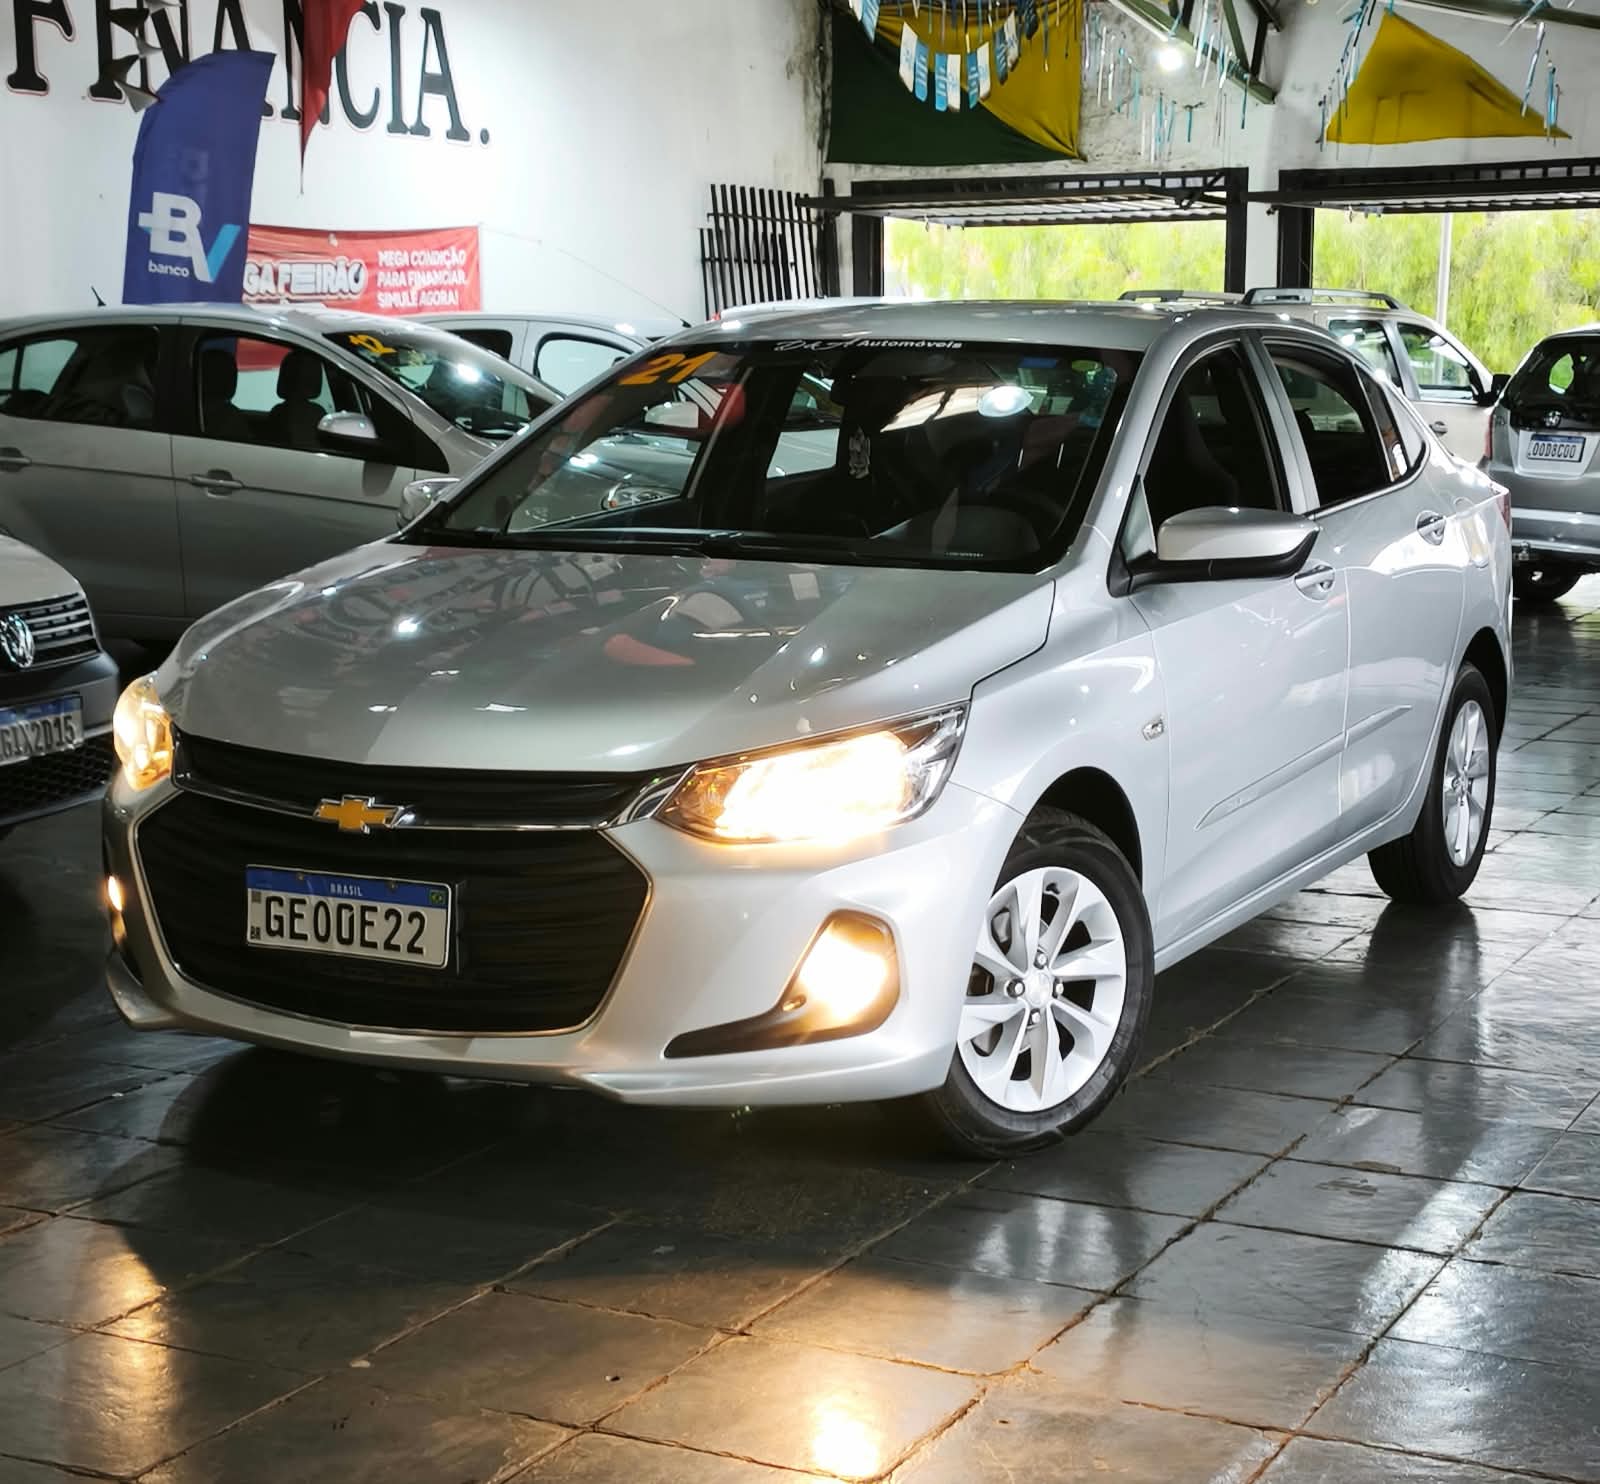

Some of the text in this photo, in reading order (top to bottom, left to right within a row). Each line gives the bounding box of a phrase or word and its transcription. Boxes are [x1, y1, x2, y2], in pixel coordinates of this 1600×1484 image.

[138, 191, 241, 283] BV
[377, 246, 467, 269] MEGA CONDIÇÃO
[148, 260, 190, 277] banco
[376, 271, 407, 287] PARA
[376, 290, 459, 308] SIMULE AGORA!
[858, 340, 963, 350] Automóveis
[618, 350, 719, 386] 21
[330, 882, 363, 897] BRASIL
